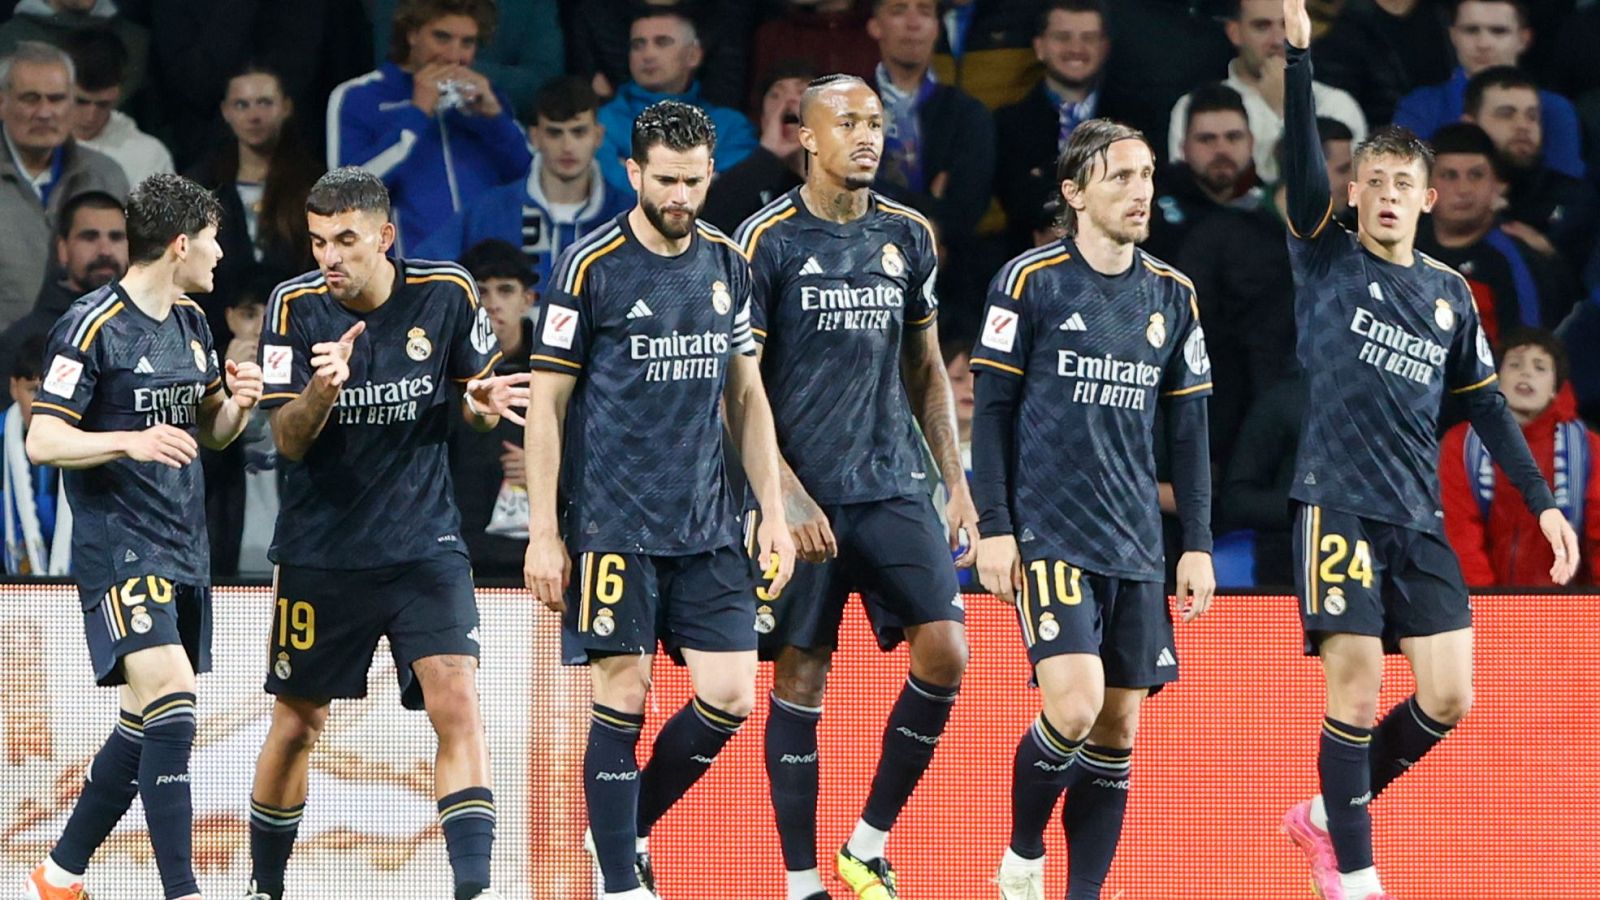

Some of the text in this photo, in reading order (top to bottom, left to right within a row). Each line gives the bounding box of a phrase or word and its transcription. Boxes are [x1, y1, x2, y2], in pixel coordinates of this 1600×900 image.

[801, 284, 904, 311] Emirates
[817, 310, 891, 331] FLY BETTER
[1350, 306, 1449, 366] Emirates
[630, 330, 729, 360] Emirates
[645, 360, 671, 382] FLY
[1057, 350, 1161, 387] Emirates
[1358, 341, 1434, 386] FLY BETTER
[134, 382, 206, 412] Emirate
[335, 374, 434, 407] mirates
[1072, 381, 1099, 404] FLY
[338, 400, 417, 425] FLY BETTER
[1320, 533, 1374, 589] 24
[120, 575, 174, 607] 20
[596, 553, 627, 605] 6
[1030, 560, 1083, 607] 10
[277, 597, 316, 651] 19
